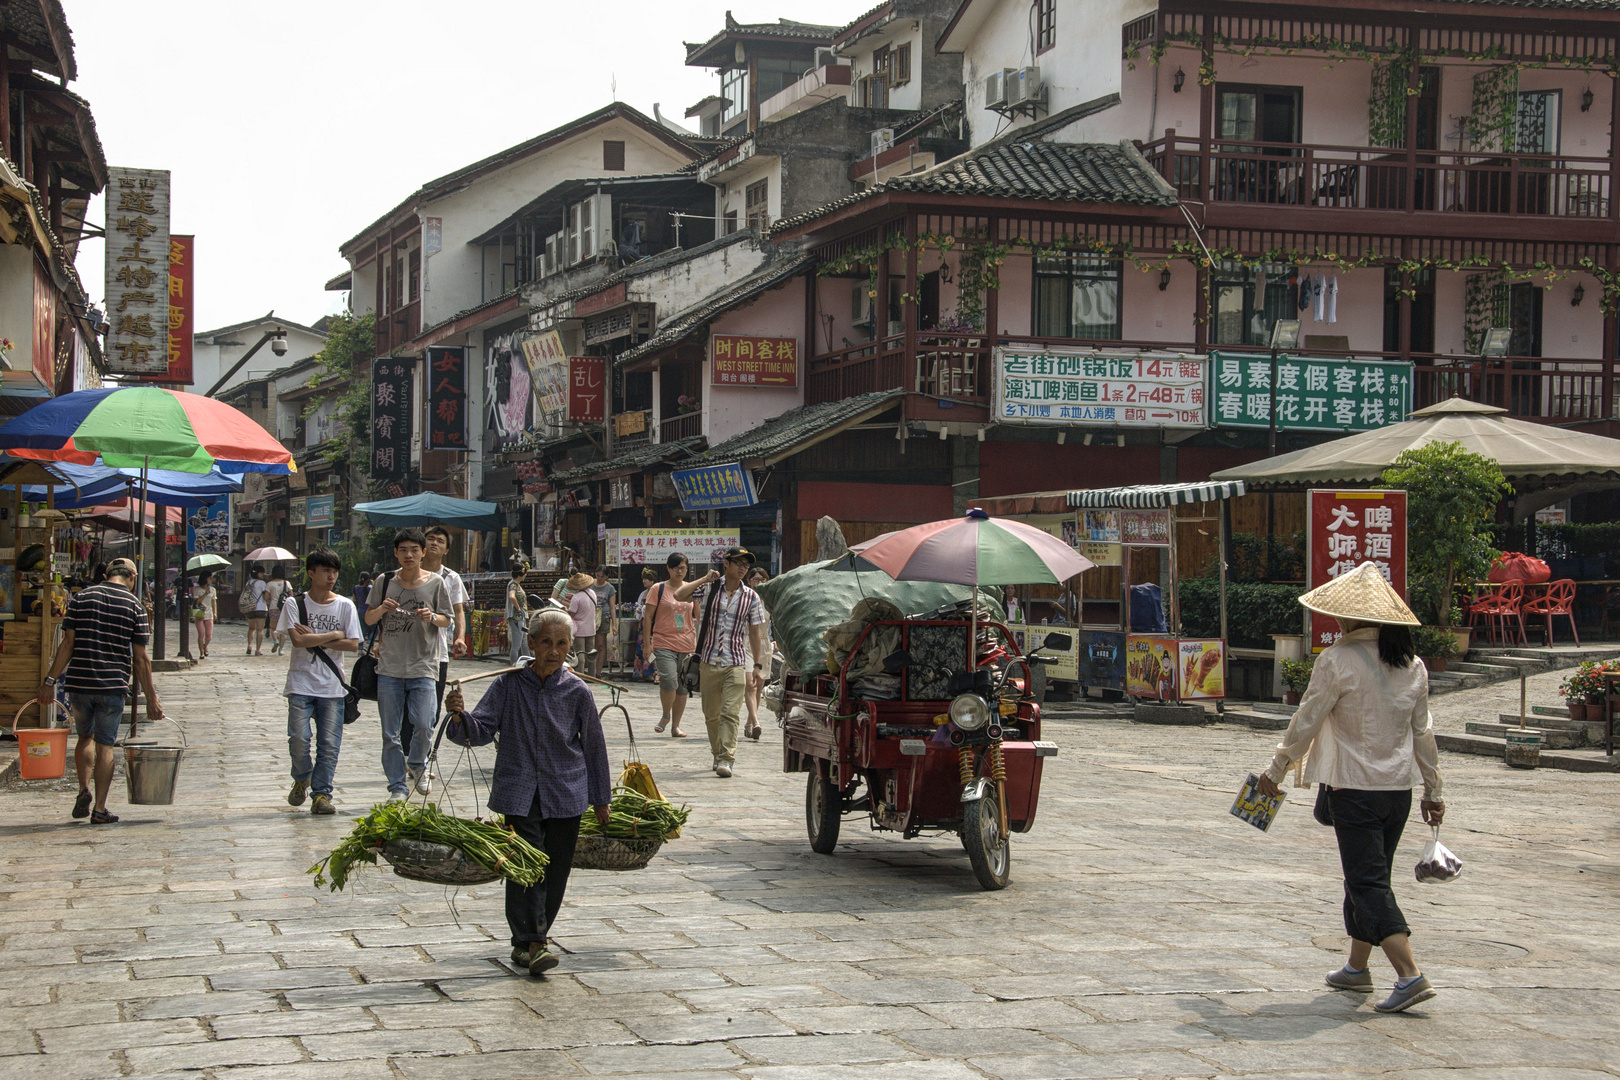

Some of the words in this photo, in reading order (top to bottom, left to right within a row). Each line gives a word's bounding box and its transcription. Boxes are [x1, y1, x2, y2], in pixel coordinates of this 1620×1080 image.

[115, 190, 159, 365] 莲峰土特产超市
[715, 338, 795, 360] 时间客栈
[379, 365, 406, 377] 西街
[716, 360, 736, 372] WEST
[737, 361, 763, 372] STREET
[764, 362, 781, 373] TIME
[782, 362, 795, 374] INN
[1218, 359, 1386, 395] 易素度假客栈
[433, 351, 463, 426] 女人帮
[721, 373, 738, 383] 阳台
[573, 366, 600, 415] 乱了
[1005, 403, 1051, 418] 乡下小炒
[1059, 405, 1116, 420] 本地人消费
[1124, 408, 1146, 421] 巷内
[1175, 410, 1200, 423] 10米
[1218, 390, 1386, 426] 春暖花开客栈
[374, 381, 397, 472] 聚寶閣
[432, 430, 464, 445] 酒吧
[621, 537, 679, 549] 玫瑰鲜花饼
[683, 537, 738, 548] 铁板鱿鱼饼
[307, 621, 341, 631] EGENDS
